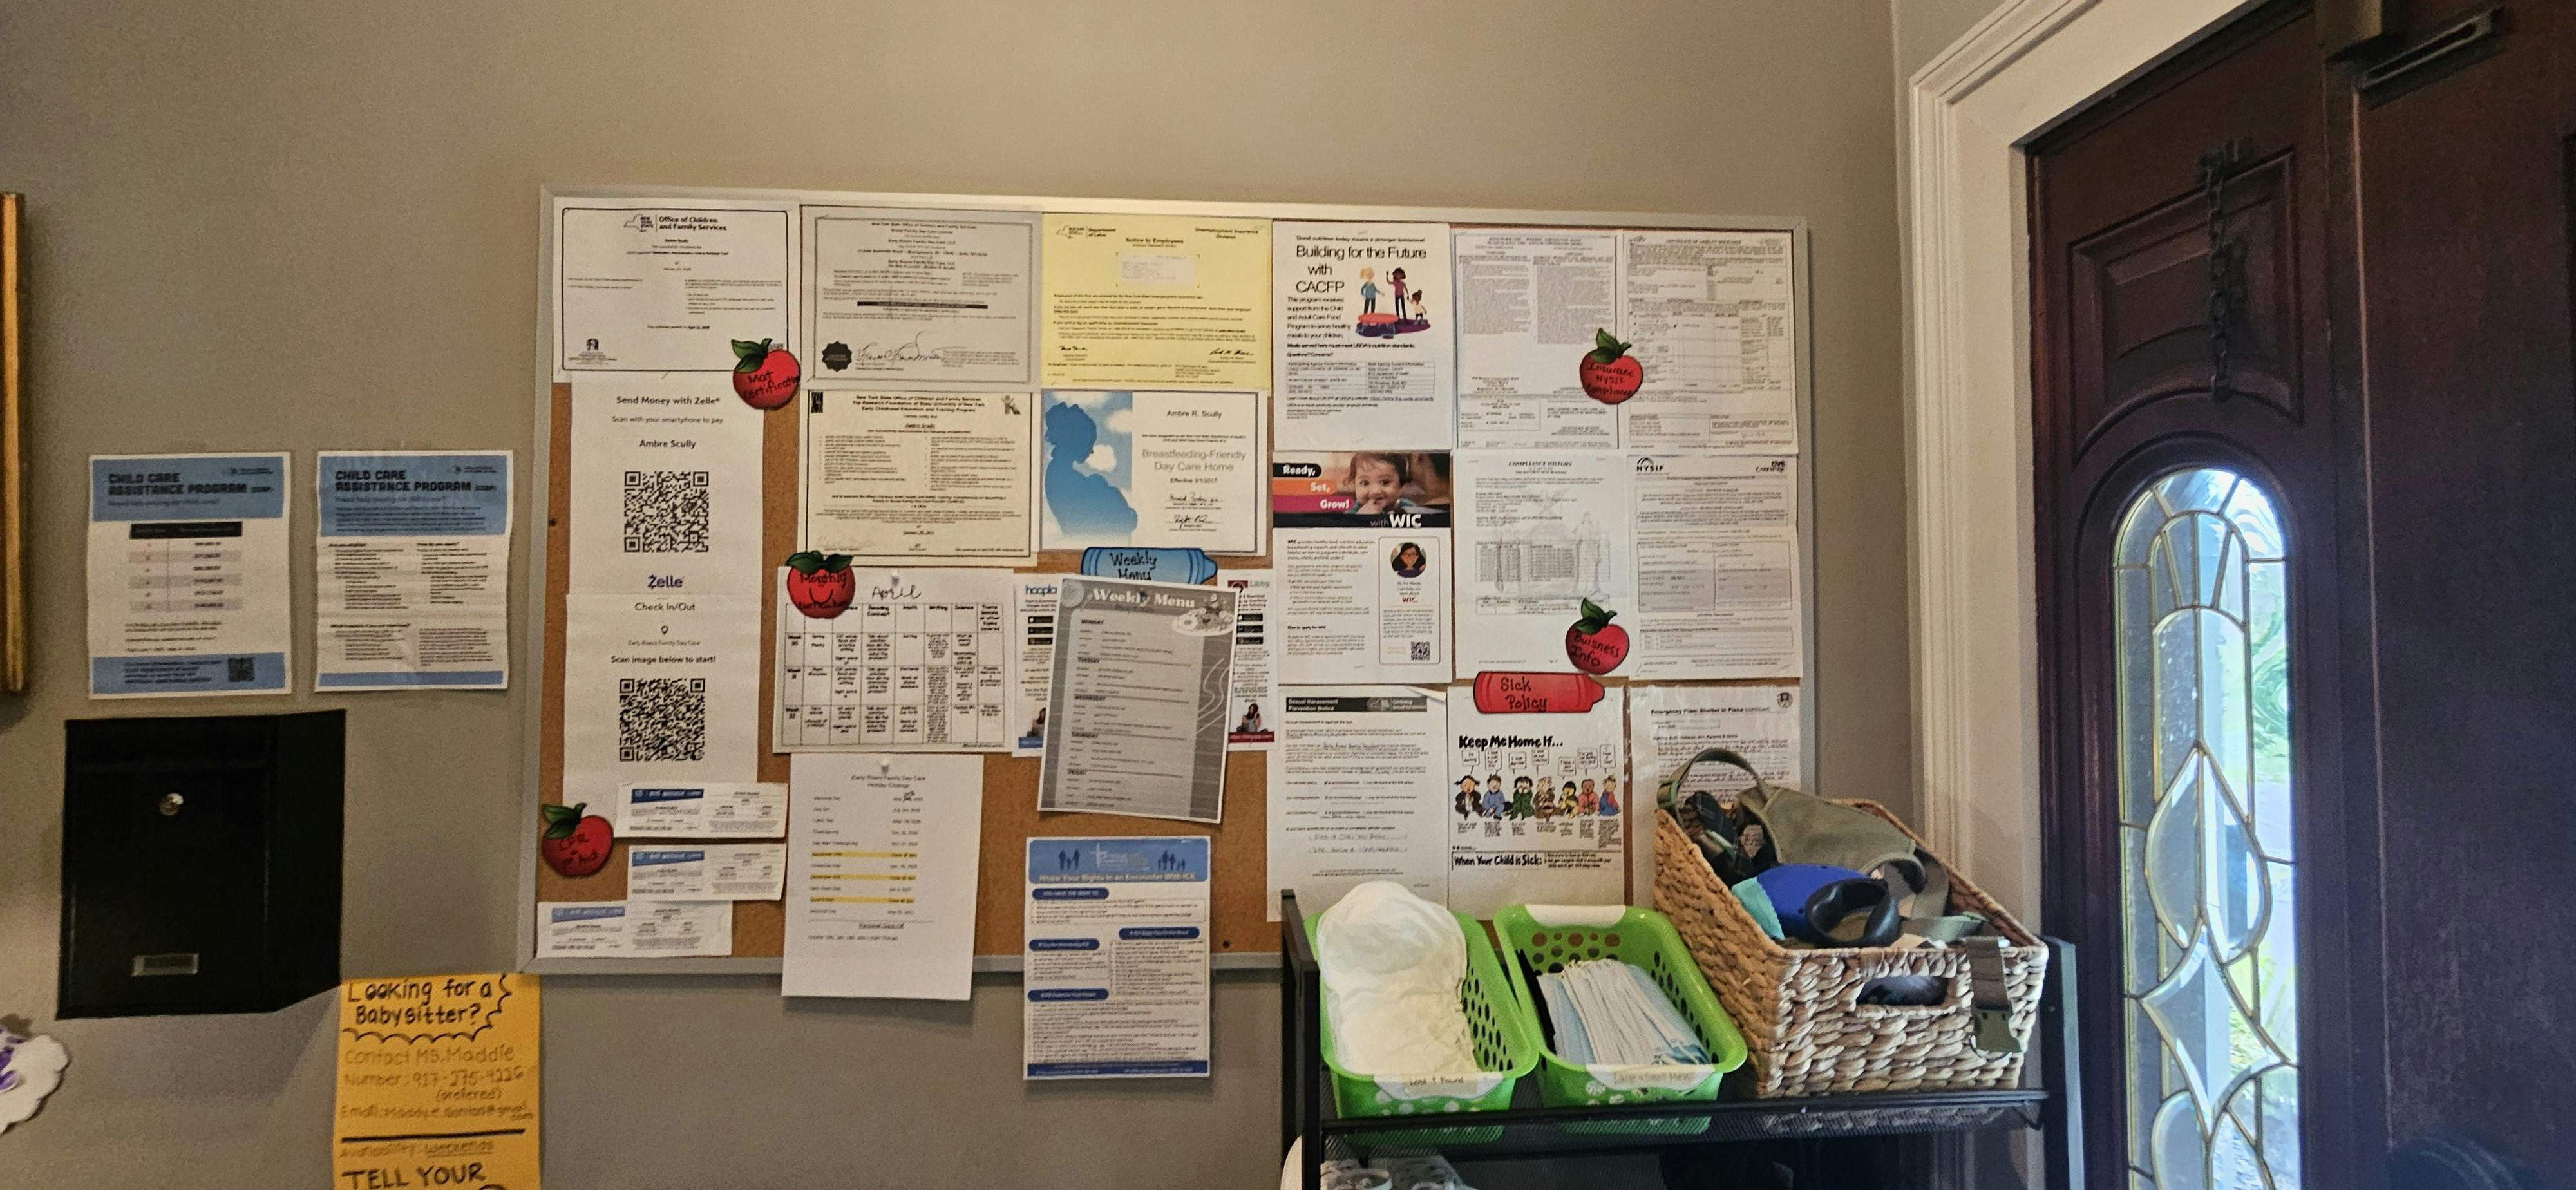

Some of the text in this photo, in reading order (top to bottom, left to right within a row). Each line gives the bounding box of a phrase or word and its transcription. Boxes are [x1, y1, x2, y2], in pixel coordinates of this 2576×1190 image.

[1296, 245, 1426, 260] Building for the Future
[1308, 264, 1332, 275] with
[1296, 281, 1345, 294] CACFP
[616, 396, 638, 404] Send
[641, 397, 670, 406] Money
[671, 440, 697, 449] Scully
[1142, 449, 1247, 460] Breastfeeding-Friendly
[1155, 462, 1234, 471] Day Care Home
[1283, 464, 1315, 477] Ready,
[108, 473, 180, 483] CHILD CARE
[336, 470, 406, 480] CHILD CARE
[108, 483, 247, 496] ASSISTANCE PROGRAM
[336, 482, 411, 492] ASSISTANCE
[414, 481, 471, 491] PROGRAM
[1311, 483, 1331, 493] Set,
[1320, 499, 1350, 509] Grow!
[1389, 513, 1422, 528] WIC
[1110, 551, 1157, 569] Weekly
[1118, 569, 1153, 580] Menu
[647, 574, 683, 590] Zelle
[872, 584, 922, 601] April
[1025, 585, 1057, 596] hoopla
[1092, 588, 1195, 608] Weekly Menu
[635, 602, 696, 612] Check In/Out
[632, 656, 656, 665] image
[1571, 645, 1600, 666] Info
[1501, 677, 1531, 691] Sick
[1506, 694, 1548, 710] Policy
[1459, 735, 1563, 752] Keep Me Home If...
[1454, 856, 1475, 866] When
[1476, 855, 1493, 865] Your
[1494, 855, 1513, 865] Child
[1515, 856, 1521, 865] is
[1522, 855, 1542, 865] Sick:
[348, 978, 492, 1006] Looking for a
[355, 1002, 482, 1028] Babysitter?
[346, 1048, 411, 1066] Contact
[341, 1162, 486, 1190] TELL YOUR
